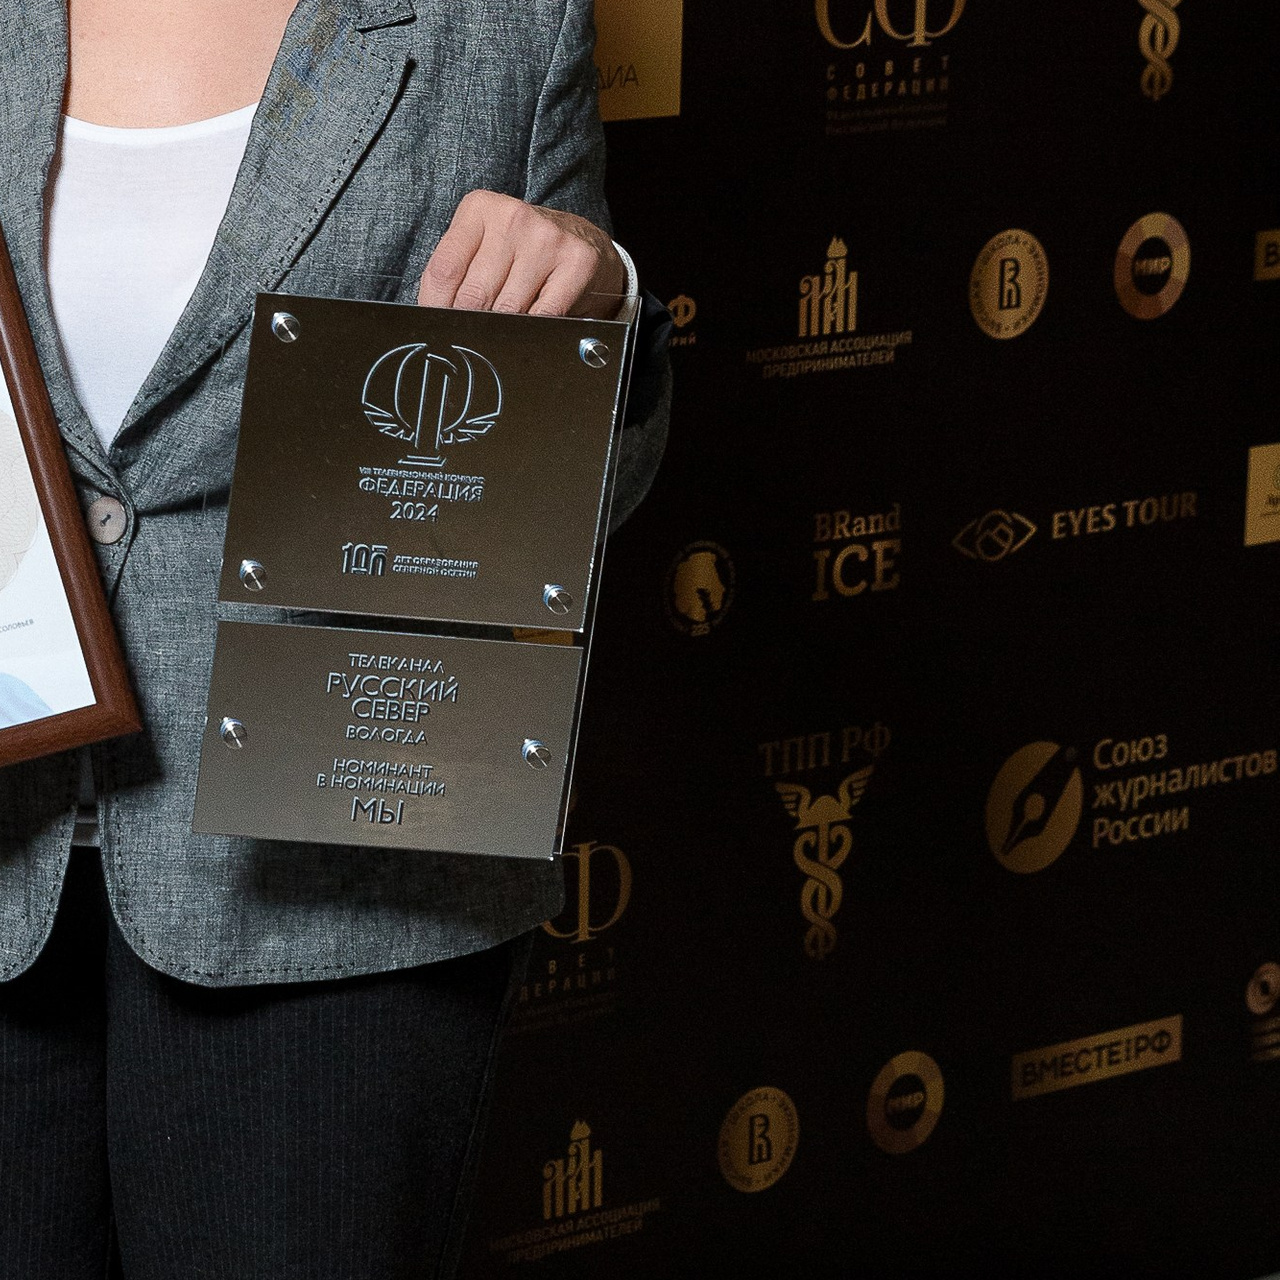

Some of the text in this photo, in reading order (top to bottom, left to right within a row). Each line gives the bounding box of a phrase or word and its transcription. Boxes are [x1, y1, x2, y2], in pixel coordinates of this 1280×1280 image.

[359, 476, 484, 503] ФЕДЕРАЦИЯ
[389, 500, 440, 522] 2024
[813, 503, 901, 544] BRand
[1050, 490, 1199, 541] EYES TOUR
[812, 538, 902, 603] ICE
[348, 653, 445, 675] ТЕЛЕКАНАЛ
[326, 672, 459, 703] РУССКИЙ
[351, 697, 431, 722] СЕВЕР
[345, 724, 428, 745] ВОЛОГДА
[757, 721, 893, 778] ТПП РФ
[1092, 733, 1169, 771] Союз
[333, 758, 433, 779] НОМИНАНТ
[1091, 748, 1279, 812] журналистов
[317, 773, 446, 797] В НОМИНАЦИИ
[350, 795, 405, 825] МЫ
[1091, 806, 1190, 848] России
